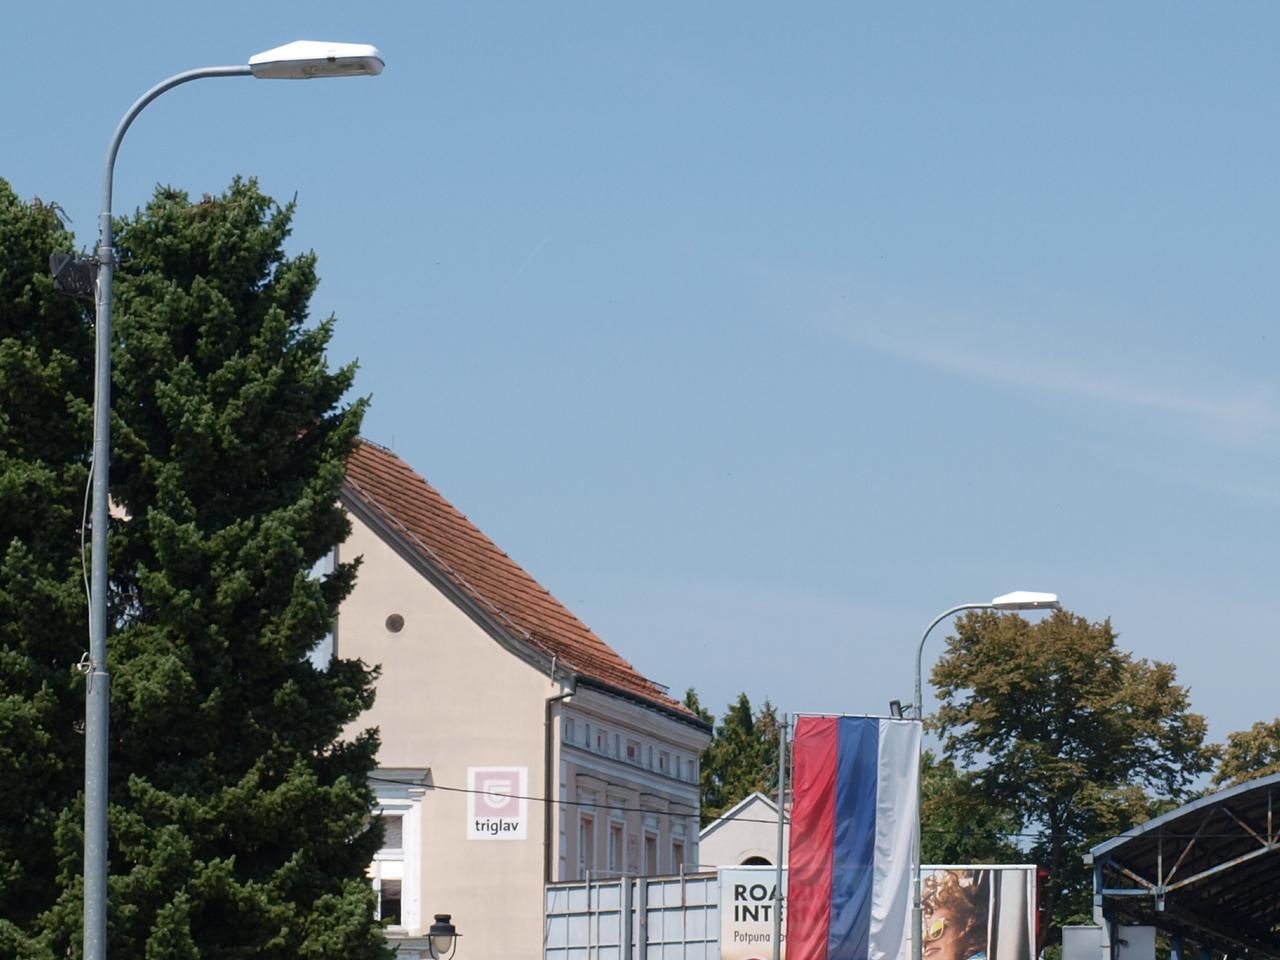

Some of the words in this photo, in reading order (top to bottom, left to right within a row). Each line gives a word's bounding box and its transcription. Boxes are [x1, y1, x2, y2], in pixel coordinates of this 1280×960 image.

[475, 819, 519, 835] triglav
[734, 884, 785, 901] ROA
[734, 931, 771, 944] Potpuna
